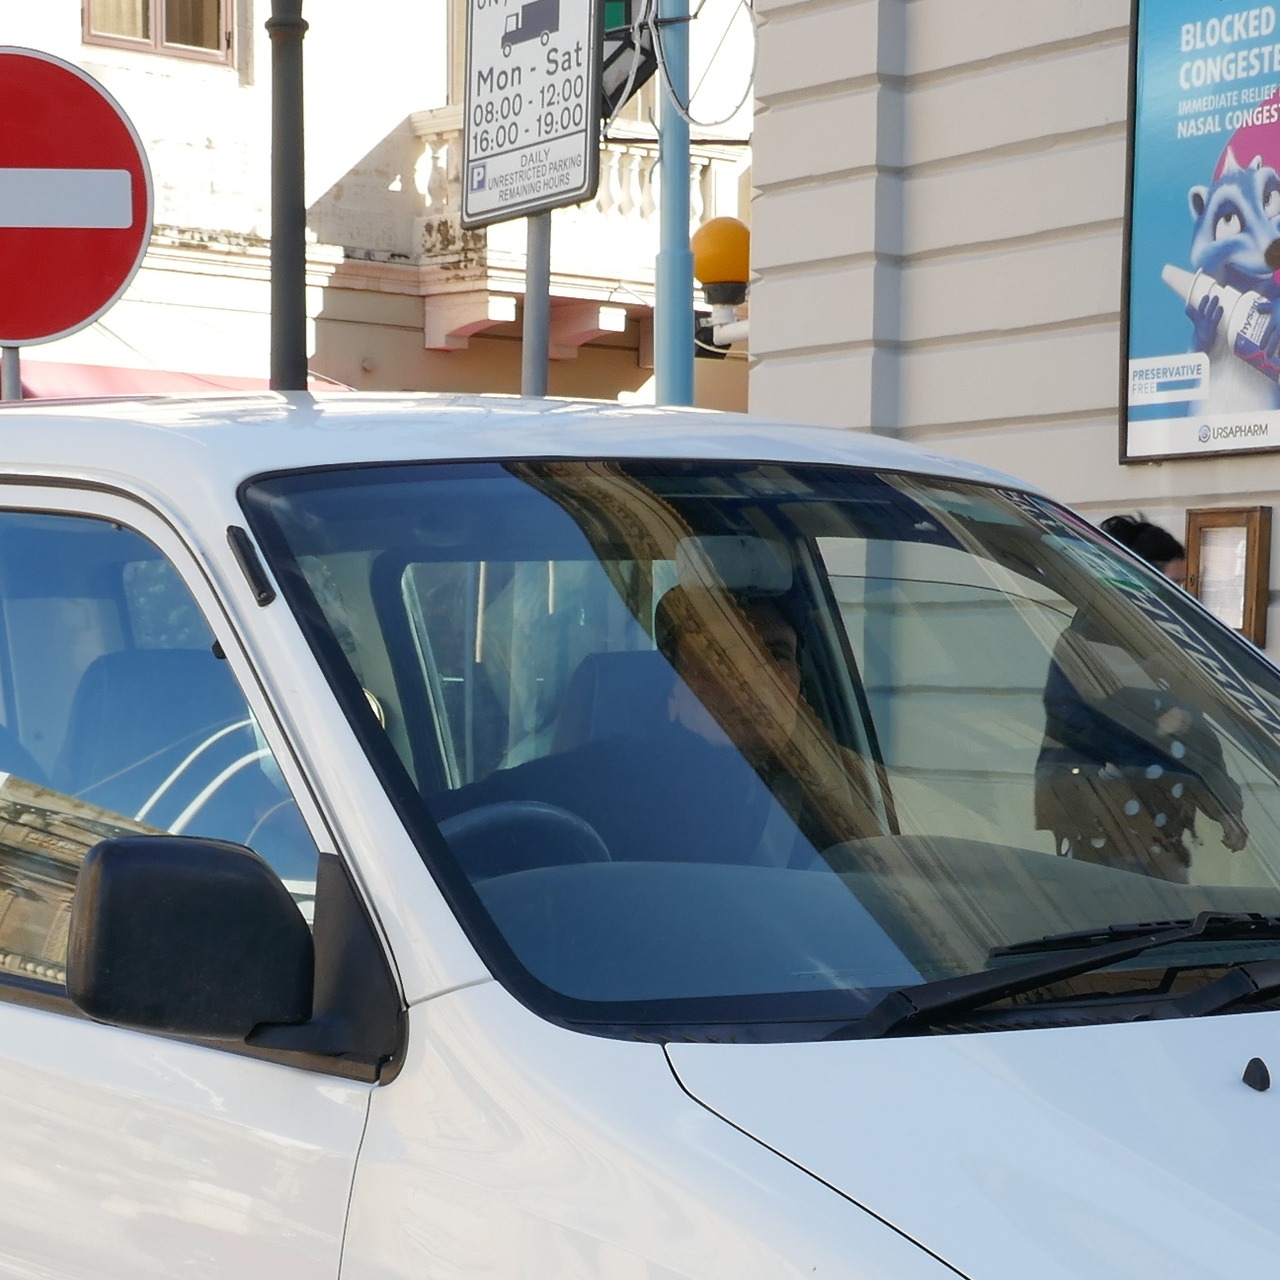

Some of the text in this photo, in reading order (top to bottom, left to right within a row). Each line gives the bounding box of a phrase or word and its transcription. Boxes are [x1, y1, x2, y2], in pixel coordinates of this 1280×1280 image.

[1181, 6, 1276, 52] BLOCKED
[477, 66, 521, 97] Mon
[545, 41, 582, 76] Sat
[473, 93, 523, 127] 08:00
[539, 75, 583, 109] 12:00
[1178, 91, 1238, 116] IMMEDIATE
[1241, 84, 1277, 104] RELIEF
[473, 122, 519, 155] 16:00
[536, 103, 583, 137] 19:00
[1177, 115, 1221, 139] NASAL
[487, 154, 582, 191] UNRESTRICTED PARKING
[520, 148, 551, 168] DAILY
[499, 173, 571, 202] REMAINING HOURS
[1132, 364, 1202, 381] PRESERVATIVE
[1132, 382, 1155, 395] FREE
[1212, 423, 1268, 440] URSAPHARM
